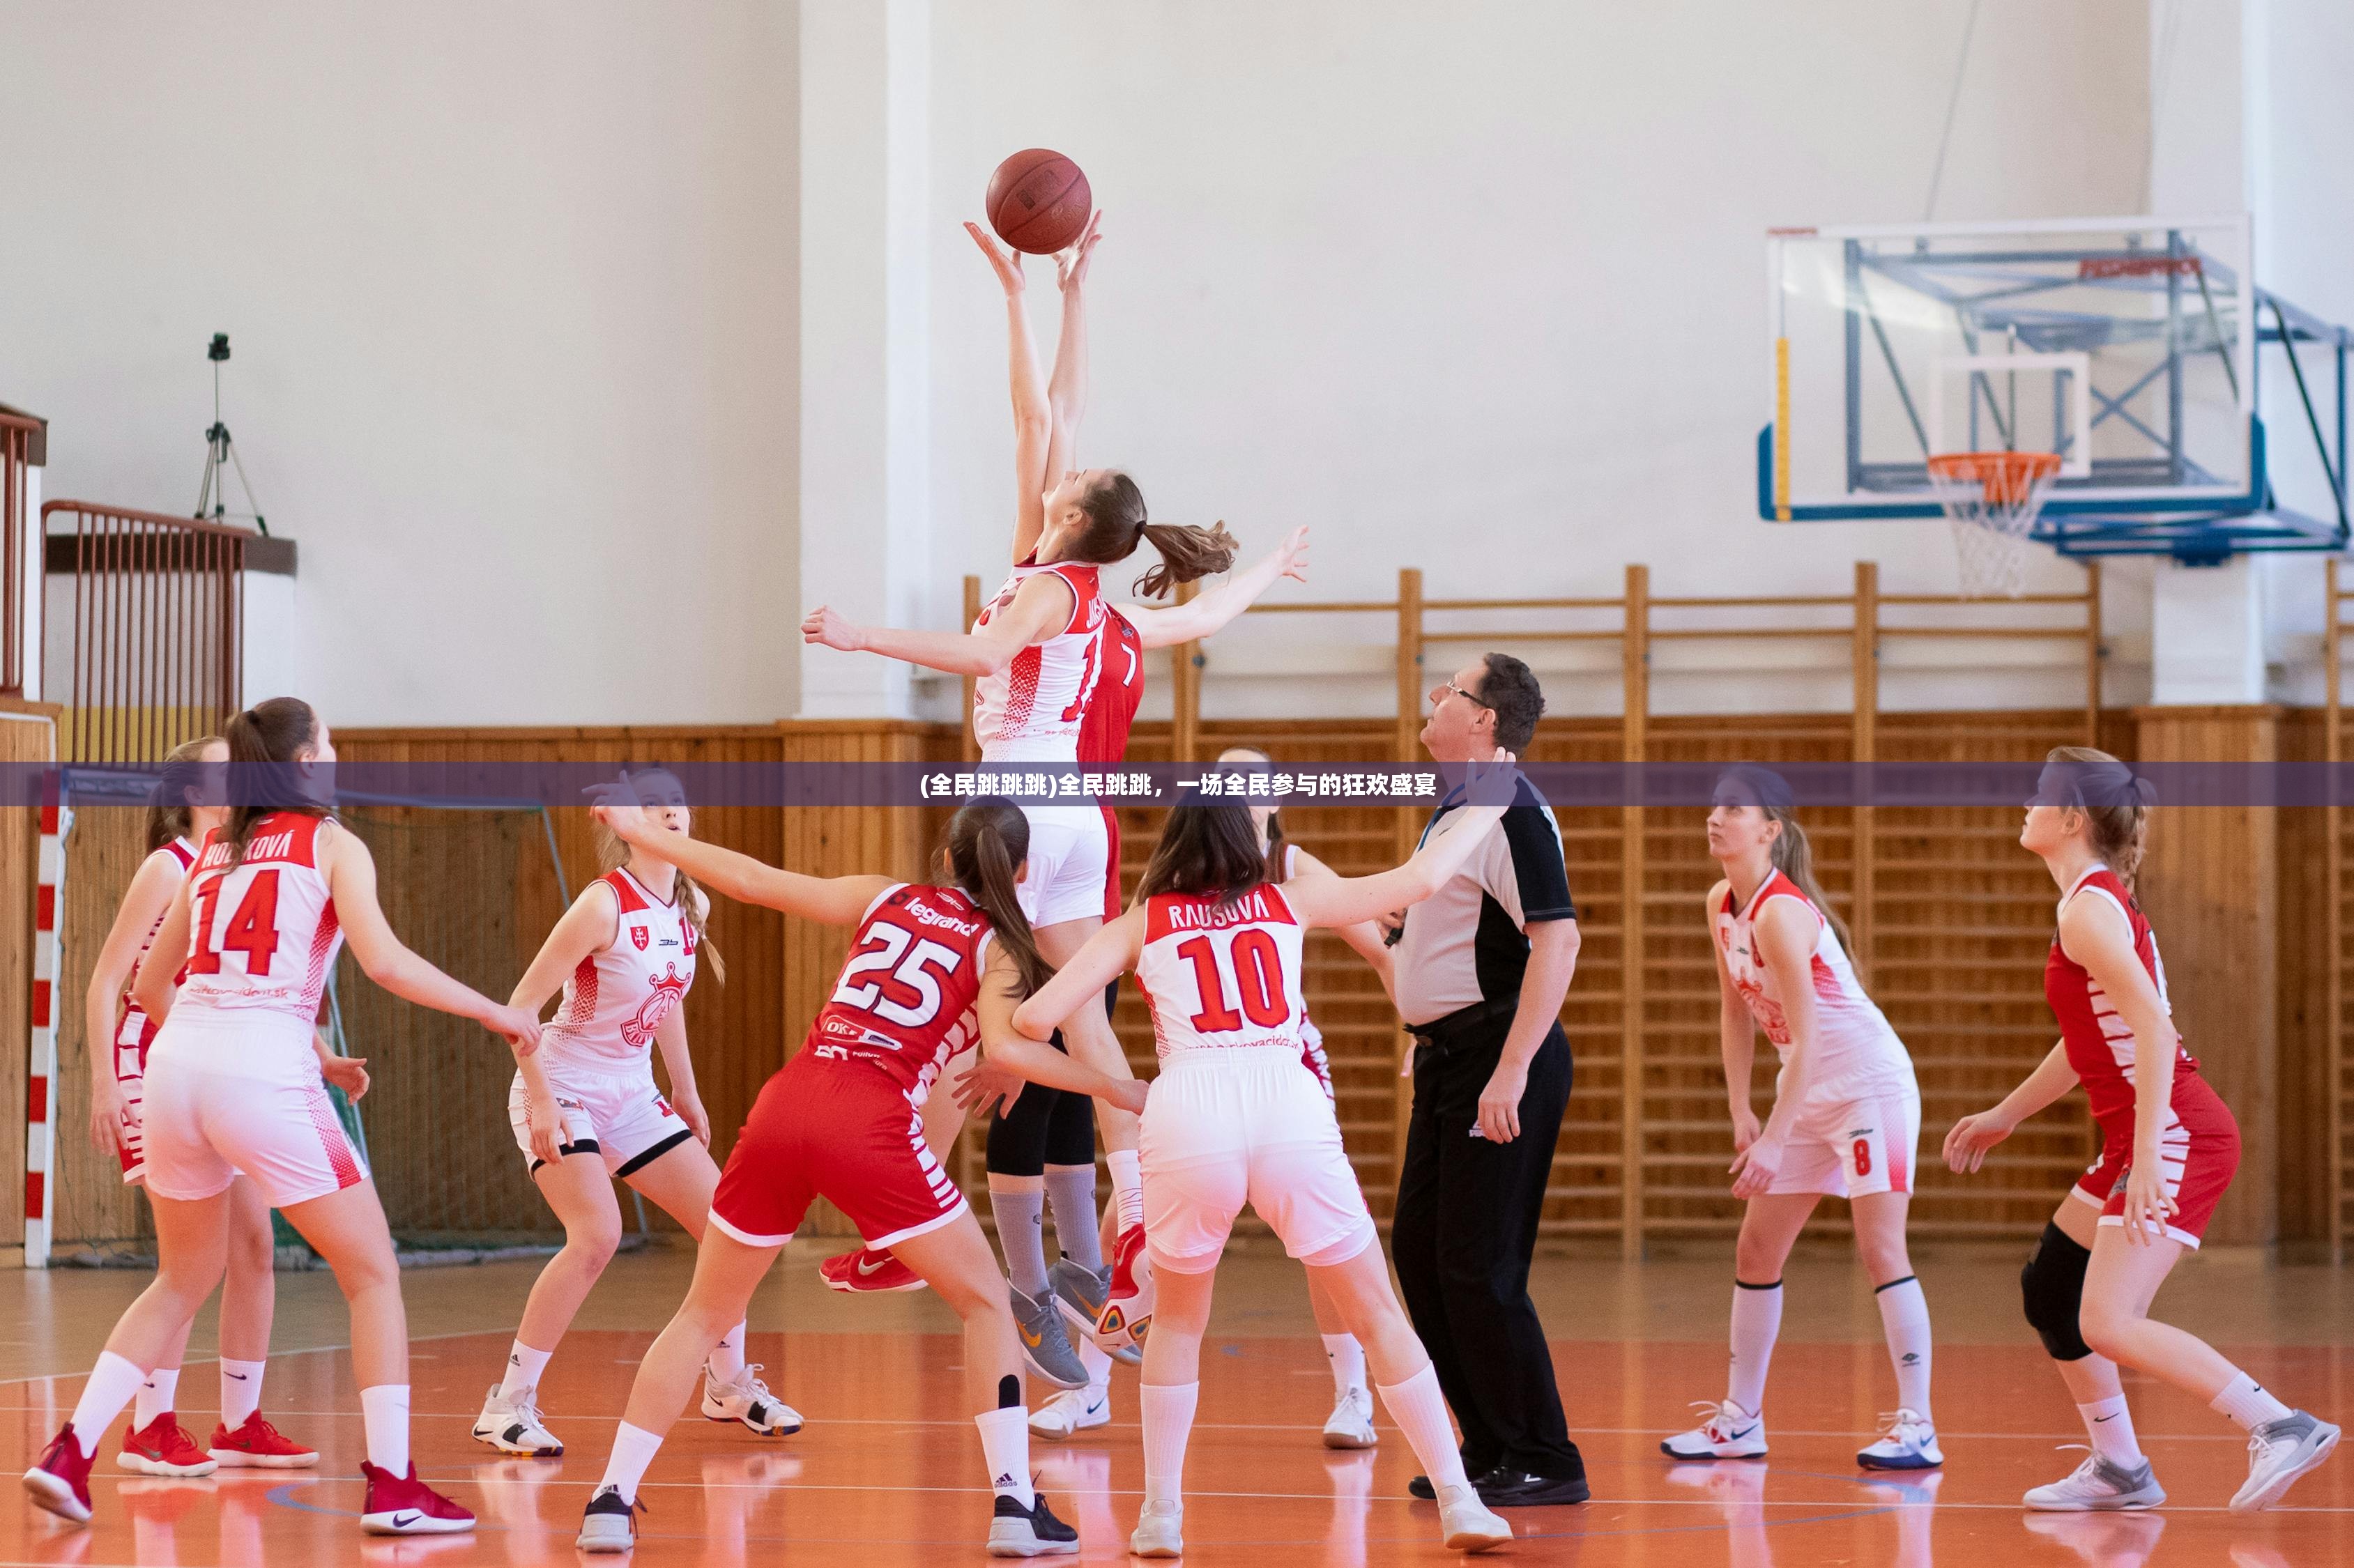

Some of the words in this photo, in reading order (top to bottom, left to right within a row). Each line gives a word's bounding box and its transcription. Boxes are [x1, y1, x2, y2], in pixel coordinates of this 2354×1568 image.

[1120, 642, 1138, 688] 7
[189, 869, 280, 977] 14
[904, 896, 980, 937] legrand
[830, 921, 963, 1028] 25
[1176, 928, 1290, 1034] 10
[1853, 1137, 1872, 1177] 8
